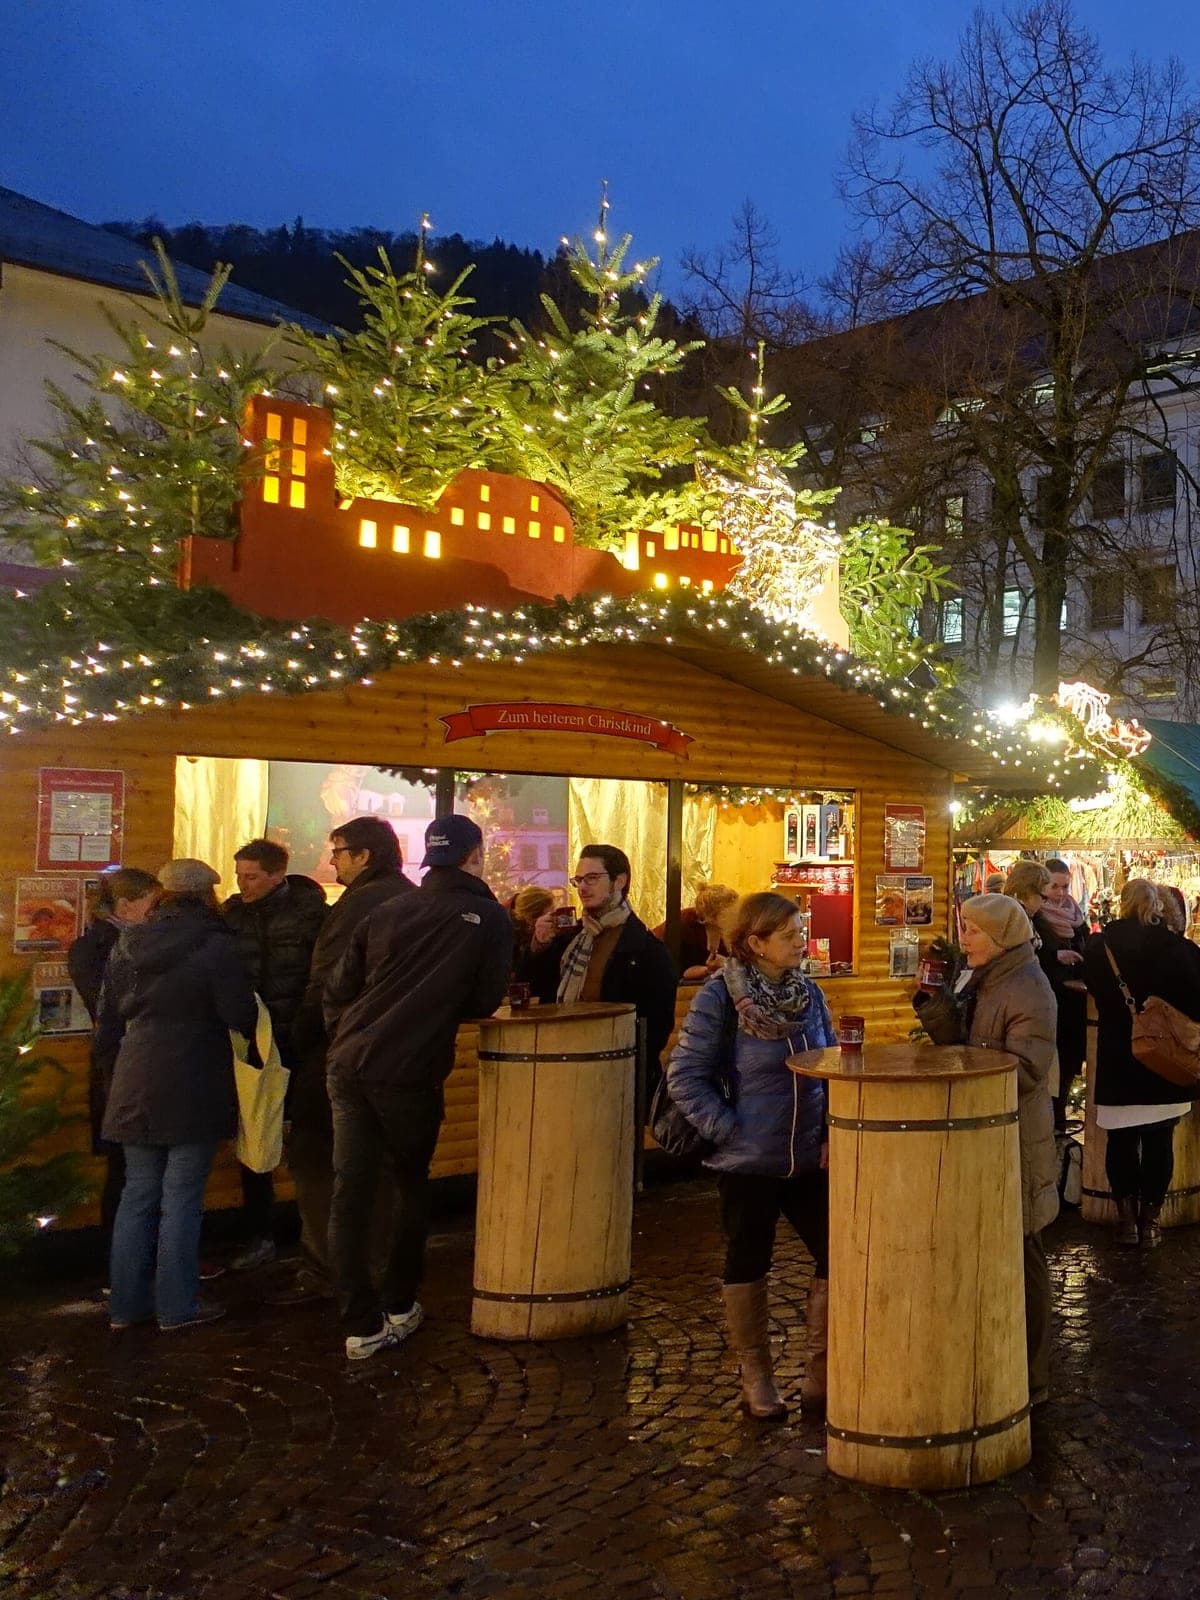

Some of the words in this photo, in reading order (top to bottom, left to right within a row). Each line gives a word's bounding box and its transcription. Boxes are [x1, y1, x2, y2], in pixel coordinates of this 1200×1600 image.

[498, 710, 529, 724] Zum
[533, 711, 585, 726] heiteren
[588, 712, 652, 735] Christkind
